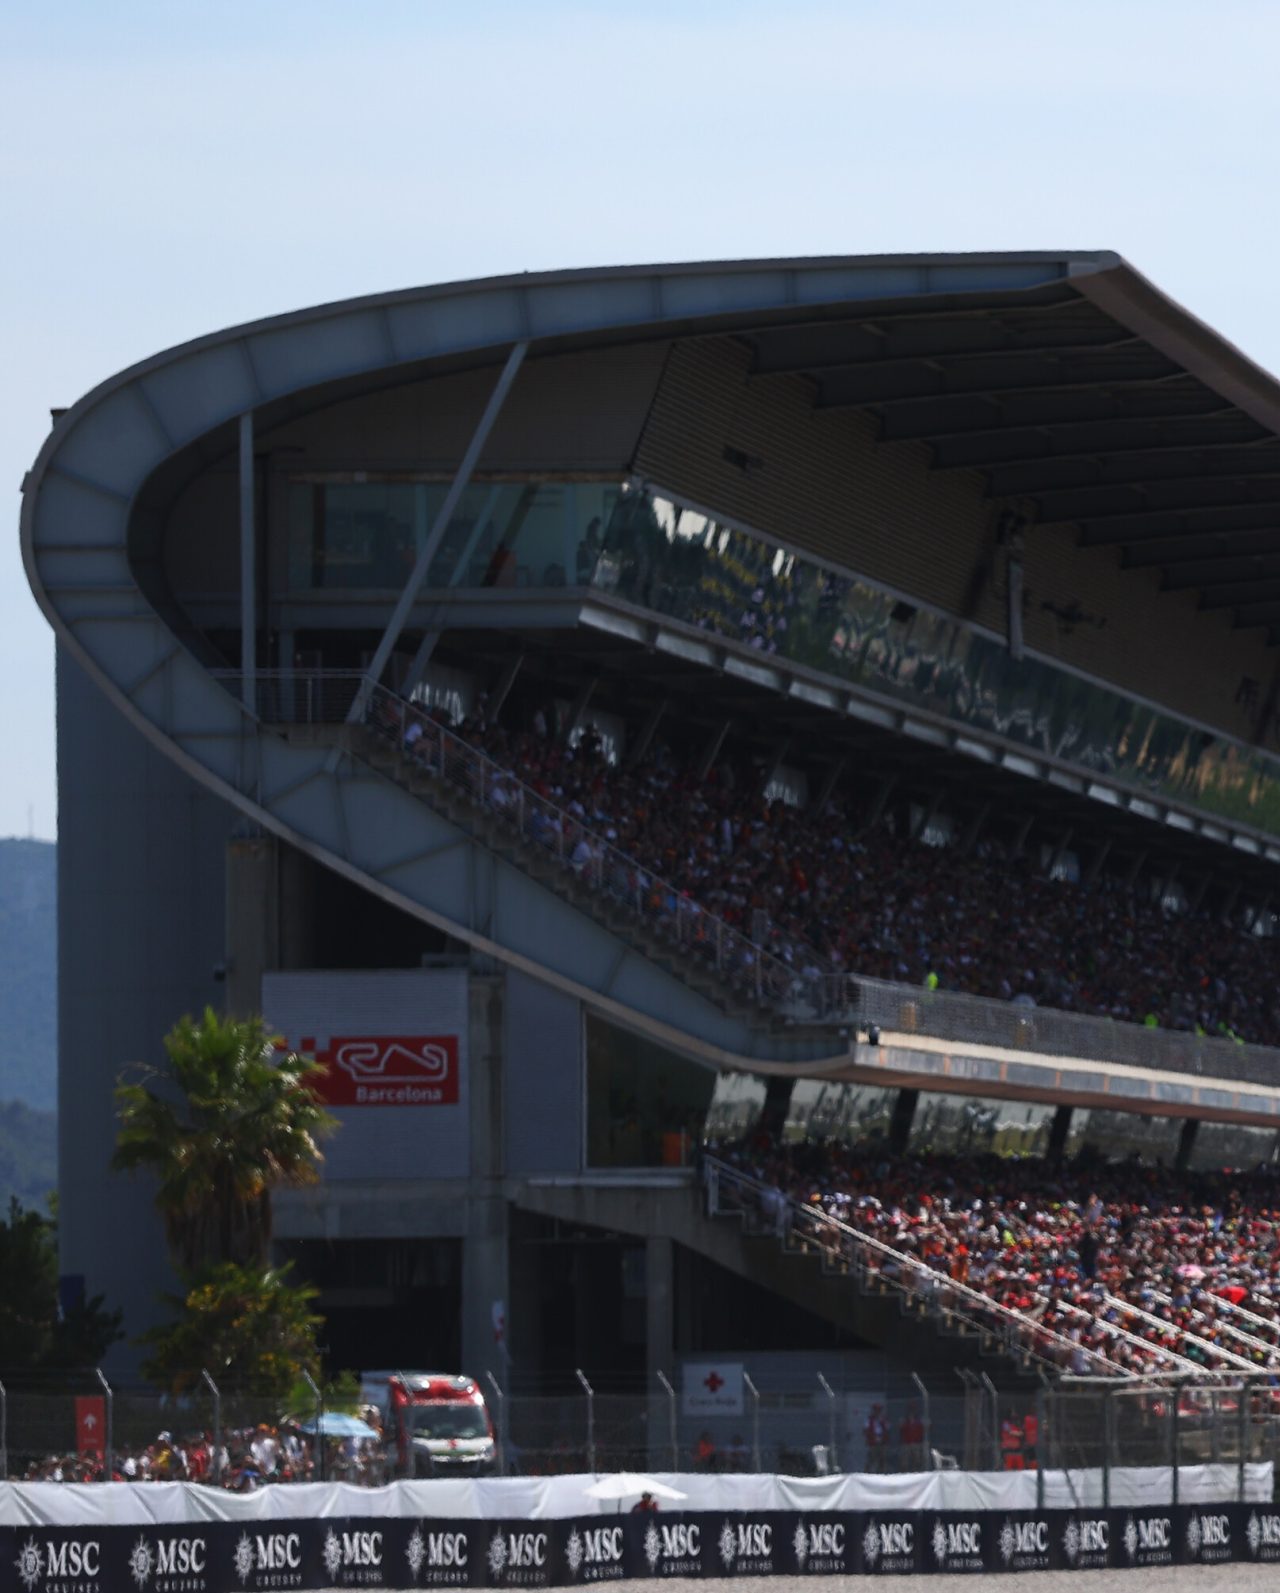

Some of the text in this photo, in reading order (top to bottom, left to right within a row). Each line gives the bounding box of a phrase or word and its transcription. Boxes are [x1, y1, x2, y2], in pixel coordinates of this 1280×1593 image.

[356, 1086, 442, 1102] Barcelona
[257, 1534, 300, 1569] MSC
[343, 1532, 382, 1564] MSC
[429, 1533, 466, 1565] MSC
[509, 1534, 547, 1565] MSC
[585, 1527, 622, 1561] MSC
[662, 1525, 700, 1557] MSC
[738, 1524, 771, 1555] MSC
[810, 1524, 844, 1554] MSC
[880, 1523, 913, 1554] MSC
[949, 1523, 980, 1553] MSC
[47, 1542, 99, 1576] MSC
[156, 1539, 205, 1574] MSC
